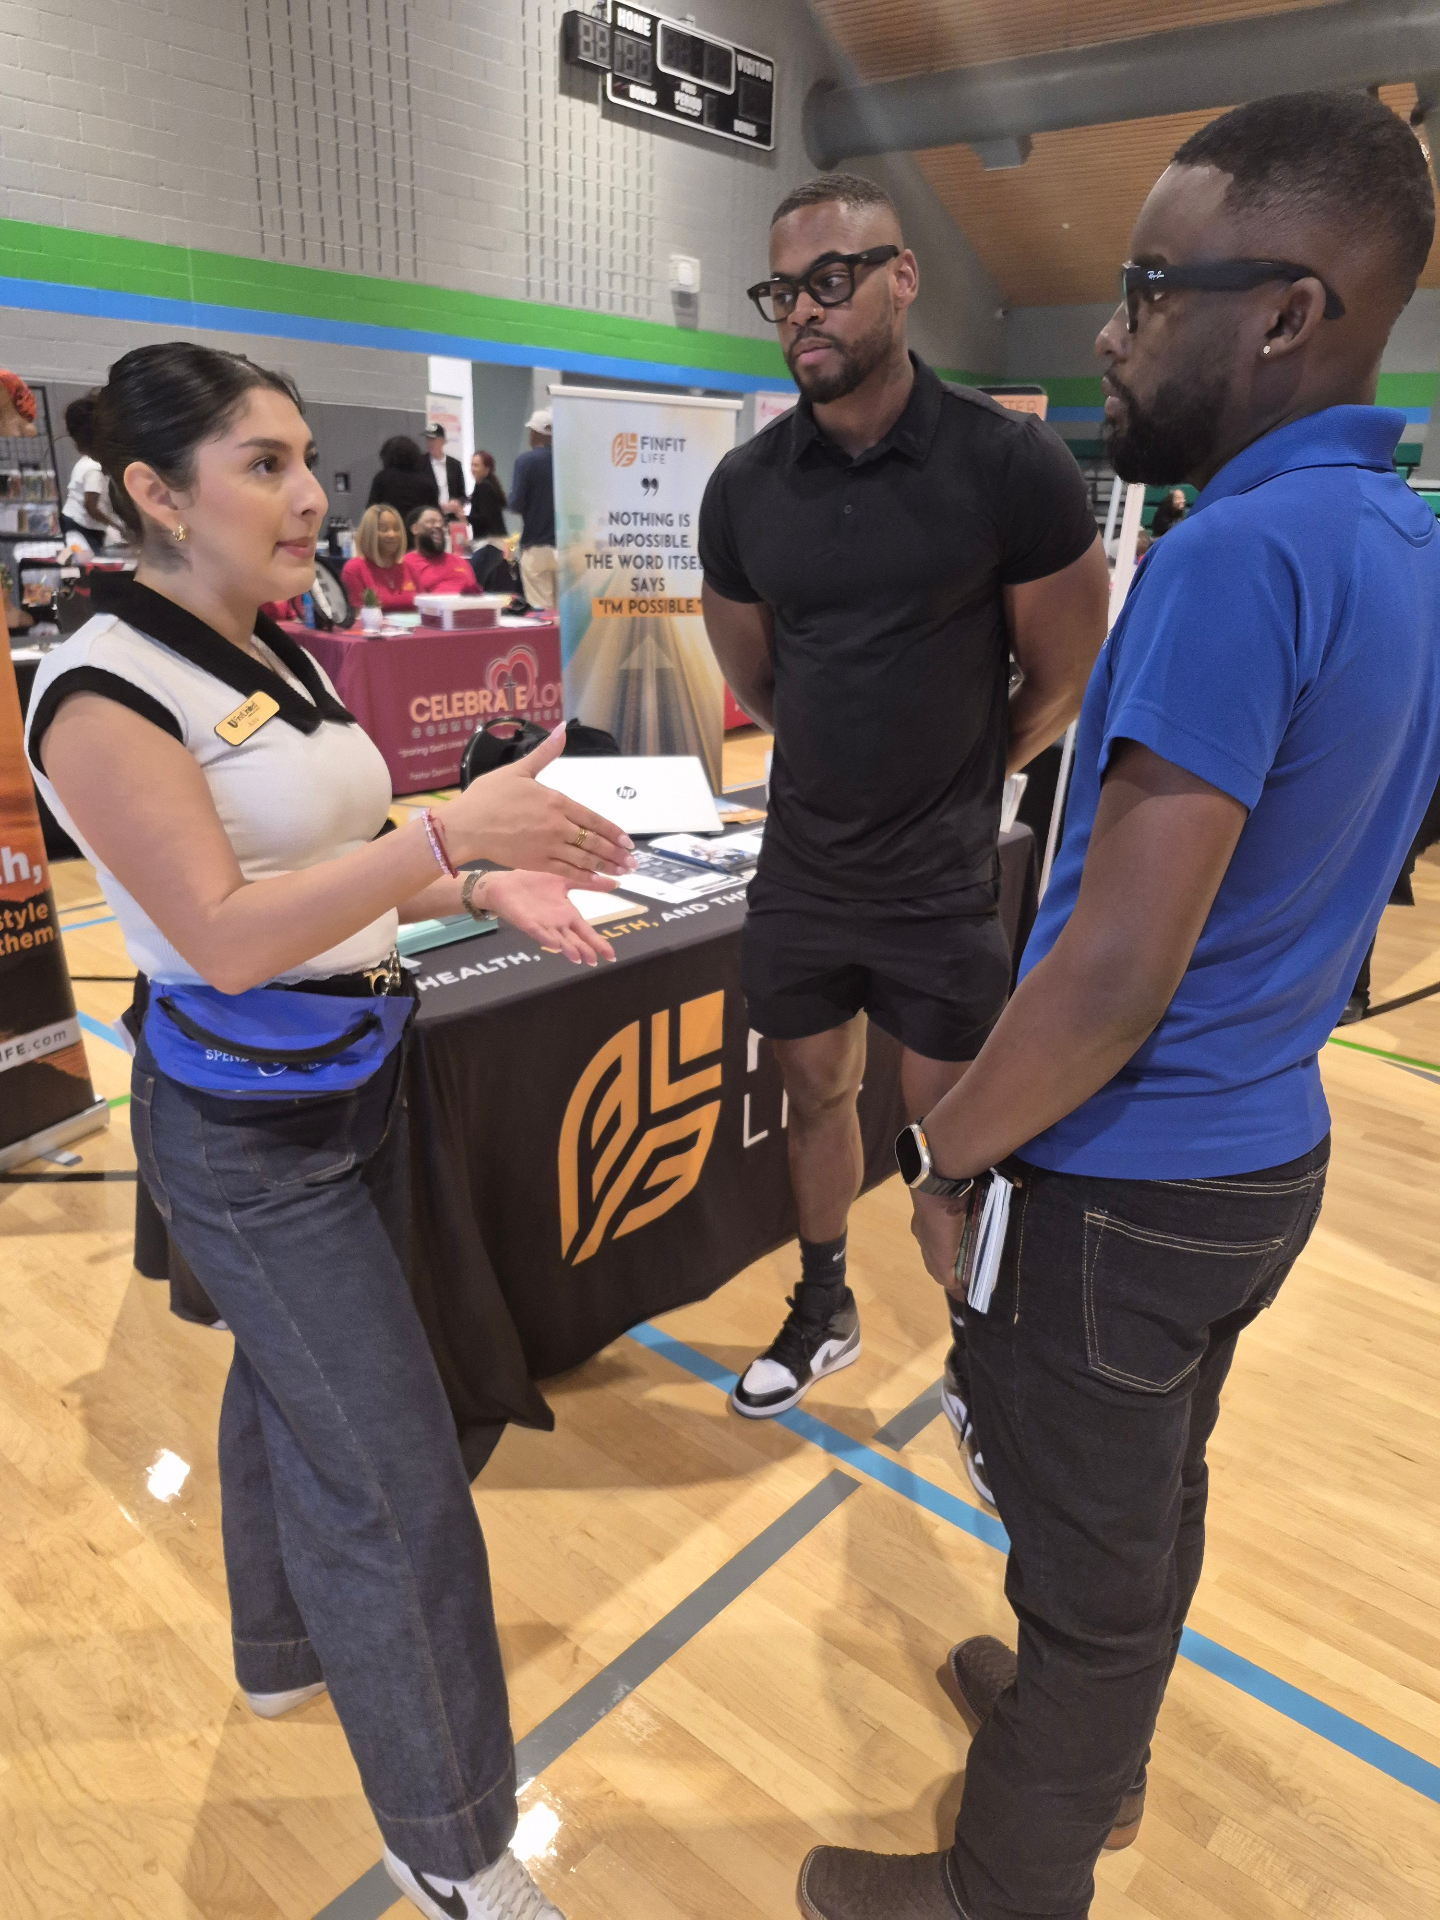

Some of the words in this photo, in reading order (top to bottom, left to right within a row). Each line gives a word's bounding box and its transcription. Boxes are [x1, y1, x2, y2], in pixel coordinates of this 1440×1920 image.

[617, 7, 652, 37] HOME
[640, 435, 686, 453] FINFIT
[640, 453, 666, 464] LIFE
[608, 511, 674, 528] NOTHING
[678, 513, 691, 528] IS
[608, 533, 691, 549] IMPOSSIBLE.
[585, 554, 613, 569] THE
[618, 554, 664, 570] WORD
[668, 555, 704, 571] ITSE
[630, 577, 665, 592] SAYS
[533, 682, 562, 709] LO
[617, 786, 637, 800] hp
[0, 845, 43, 885] h,
[415, 951, 541, 991] HEALTH,
[661, 902, 710, 922] AND
